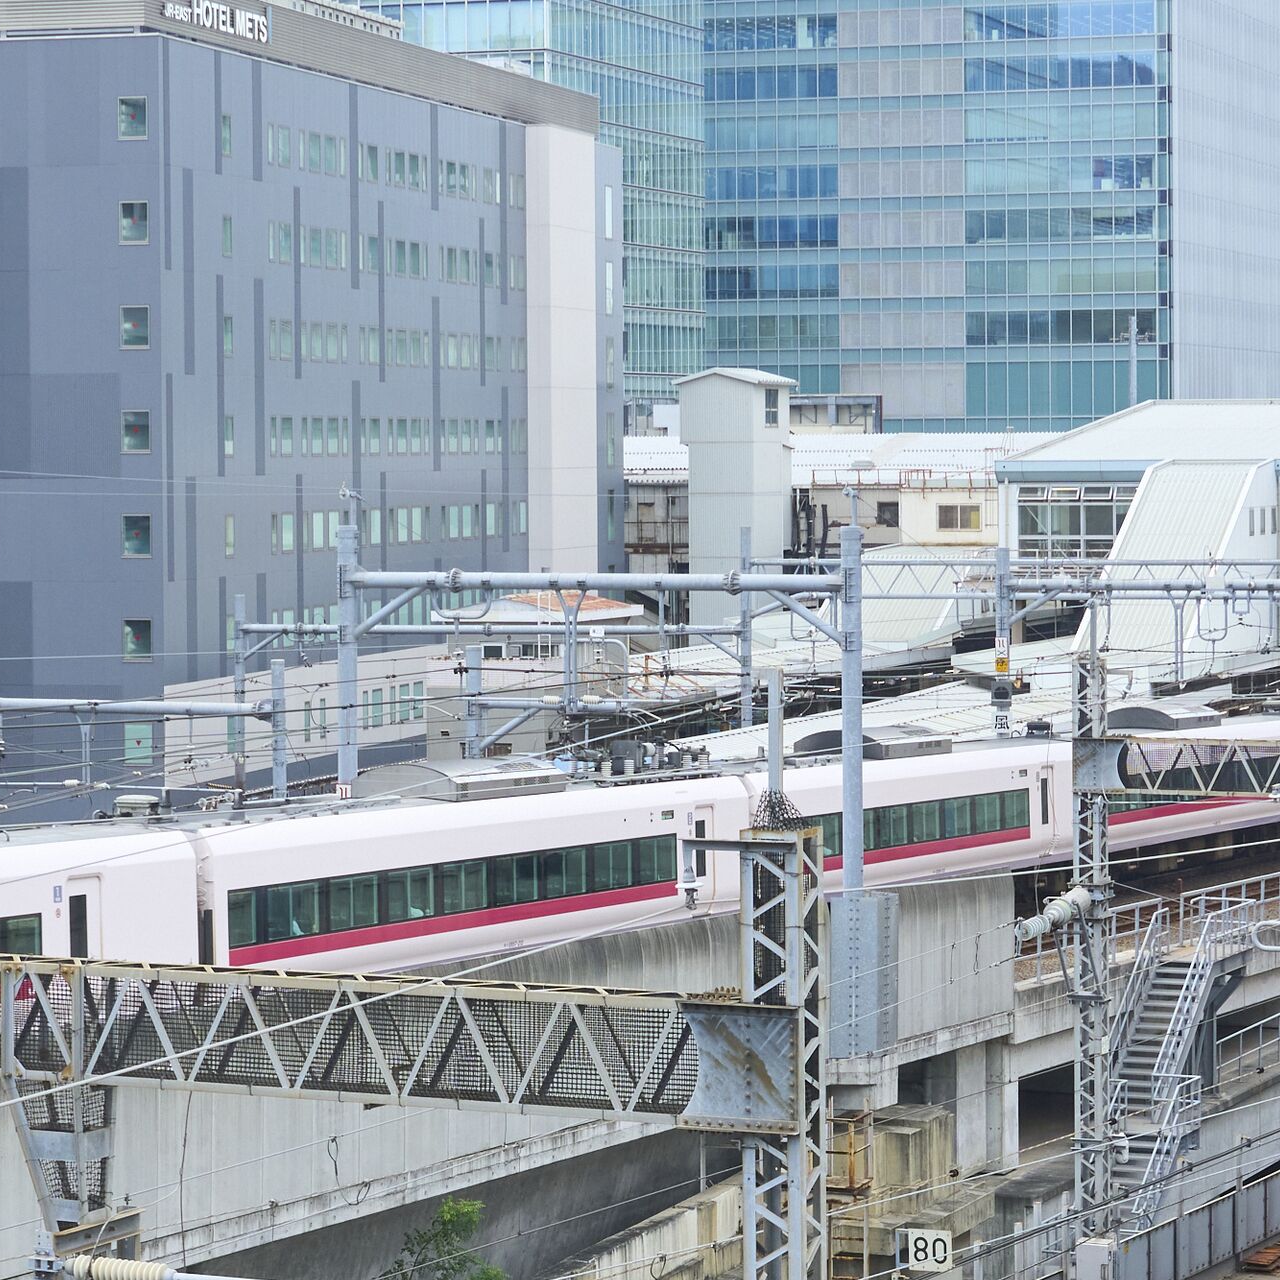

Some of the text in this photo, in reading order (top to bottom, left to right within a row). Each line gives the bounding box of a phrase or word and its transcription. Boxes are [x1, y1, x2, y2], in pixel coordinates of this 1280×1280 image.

[193, 0, 235, 34] HOTEL
[235, 9, 268, 43] METS
[994, 715, 1010, 730] 風
[913, 1236, 948, 1264] 80
